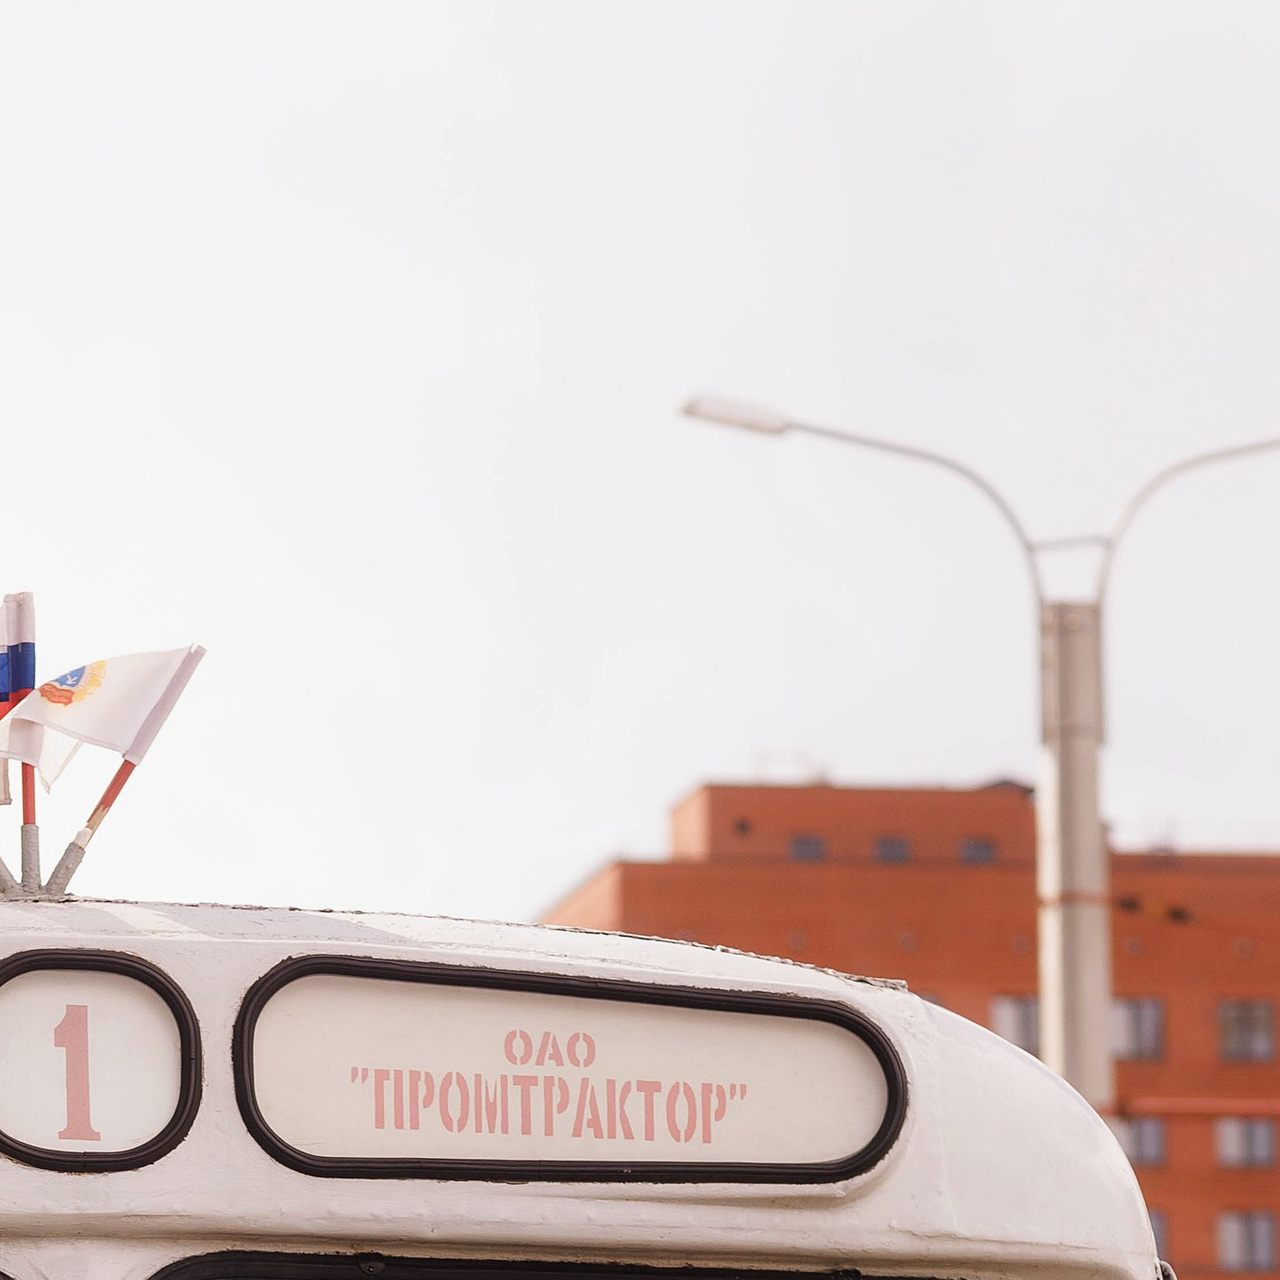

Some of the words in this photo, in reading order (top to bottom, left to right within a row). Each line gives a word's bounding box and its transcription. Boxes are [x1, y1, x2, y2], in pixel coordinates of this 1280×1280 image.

[54, 1004, 101, 1141] 1
[503, 1029, 596, 1068] ОАО
[349, 1066, 748, 1146] "ПРОМТРАКТОР"
